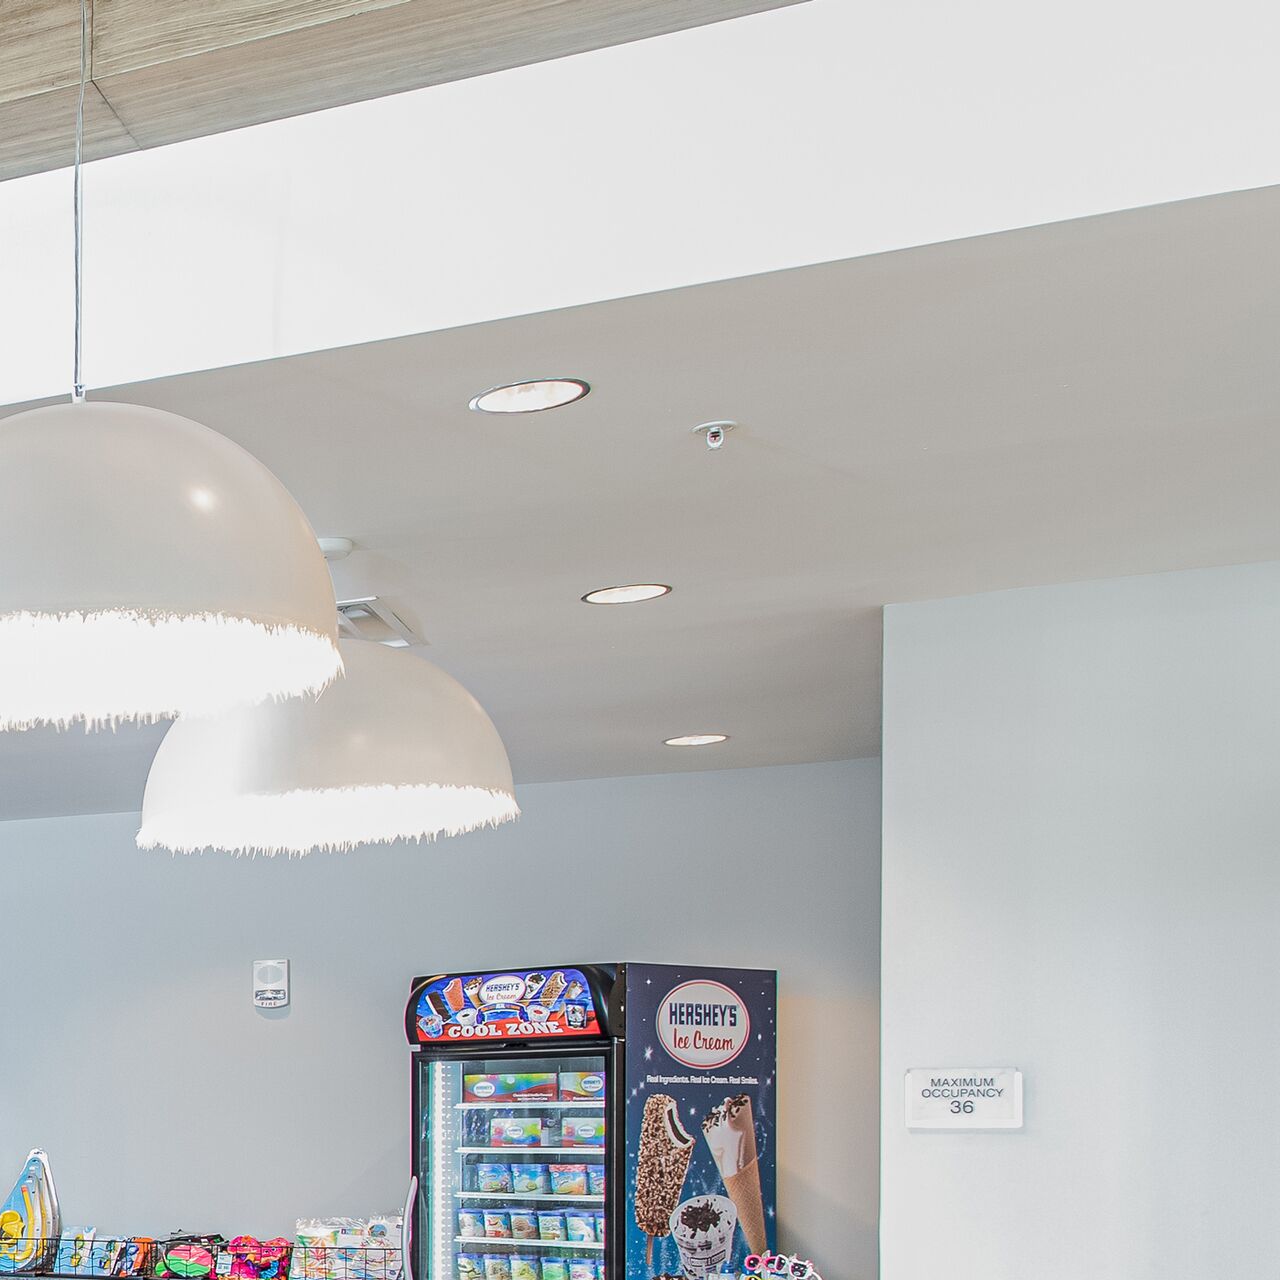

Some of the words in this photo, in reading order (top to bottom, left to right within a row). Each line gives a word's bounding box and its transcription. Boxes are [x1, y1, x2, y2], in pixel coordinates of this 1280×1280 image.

[669, 1002, 738, 1027] HERSHEY'S
[448, 1025, 503, 1038] COOL
[506, 1021, 564, 1035] ZONE
[673, 1027, 690, 1049] Ice
[693, 1029, 736, 1051] Cream
[930, 1077, 995, 1088] MAXIMUM
[921, 1088, 1004, 1098] OCCUPANCY
[950, 1100, 974, 1114] 36
